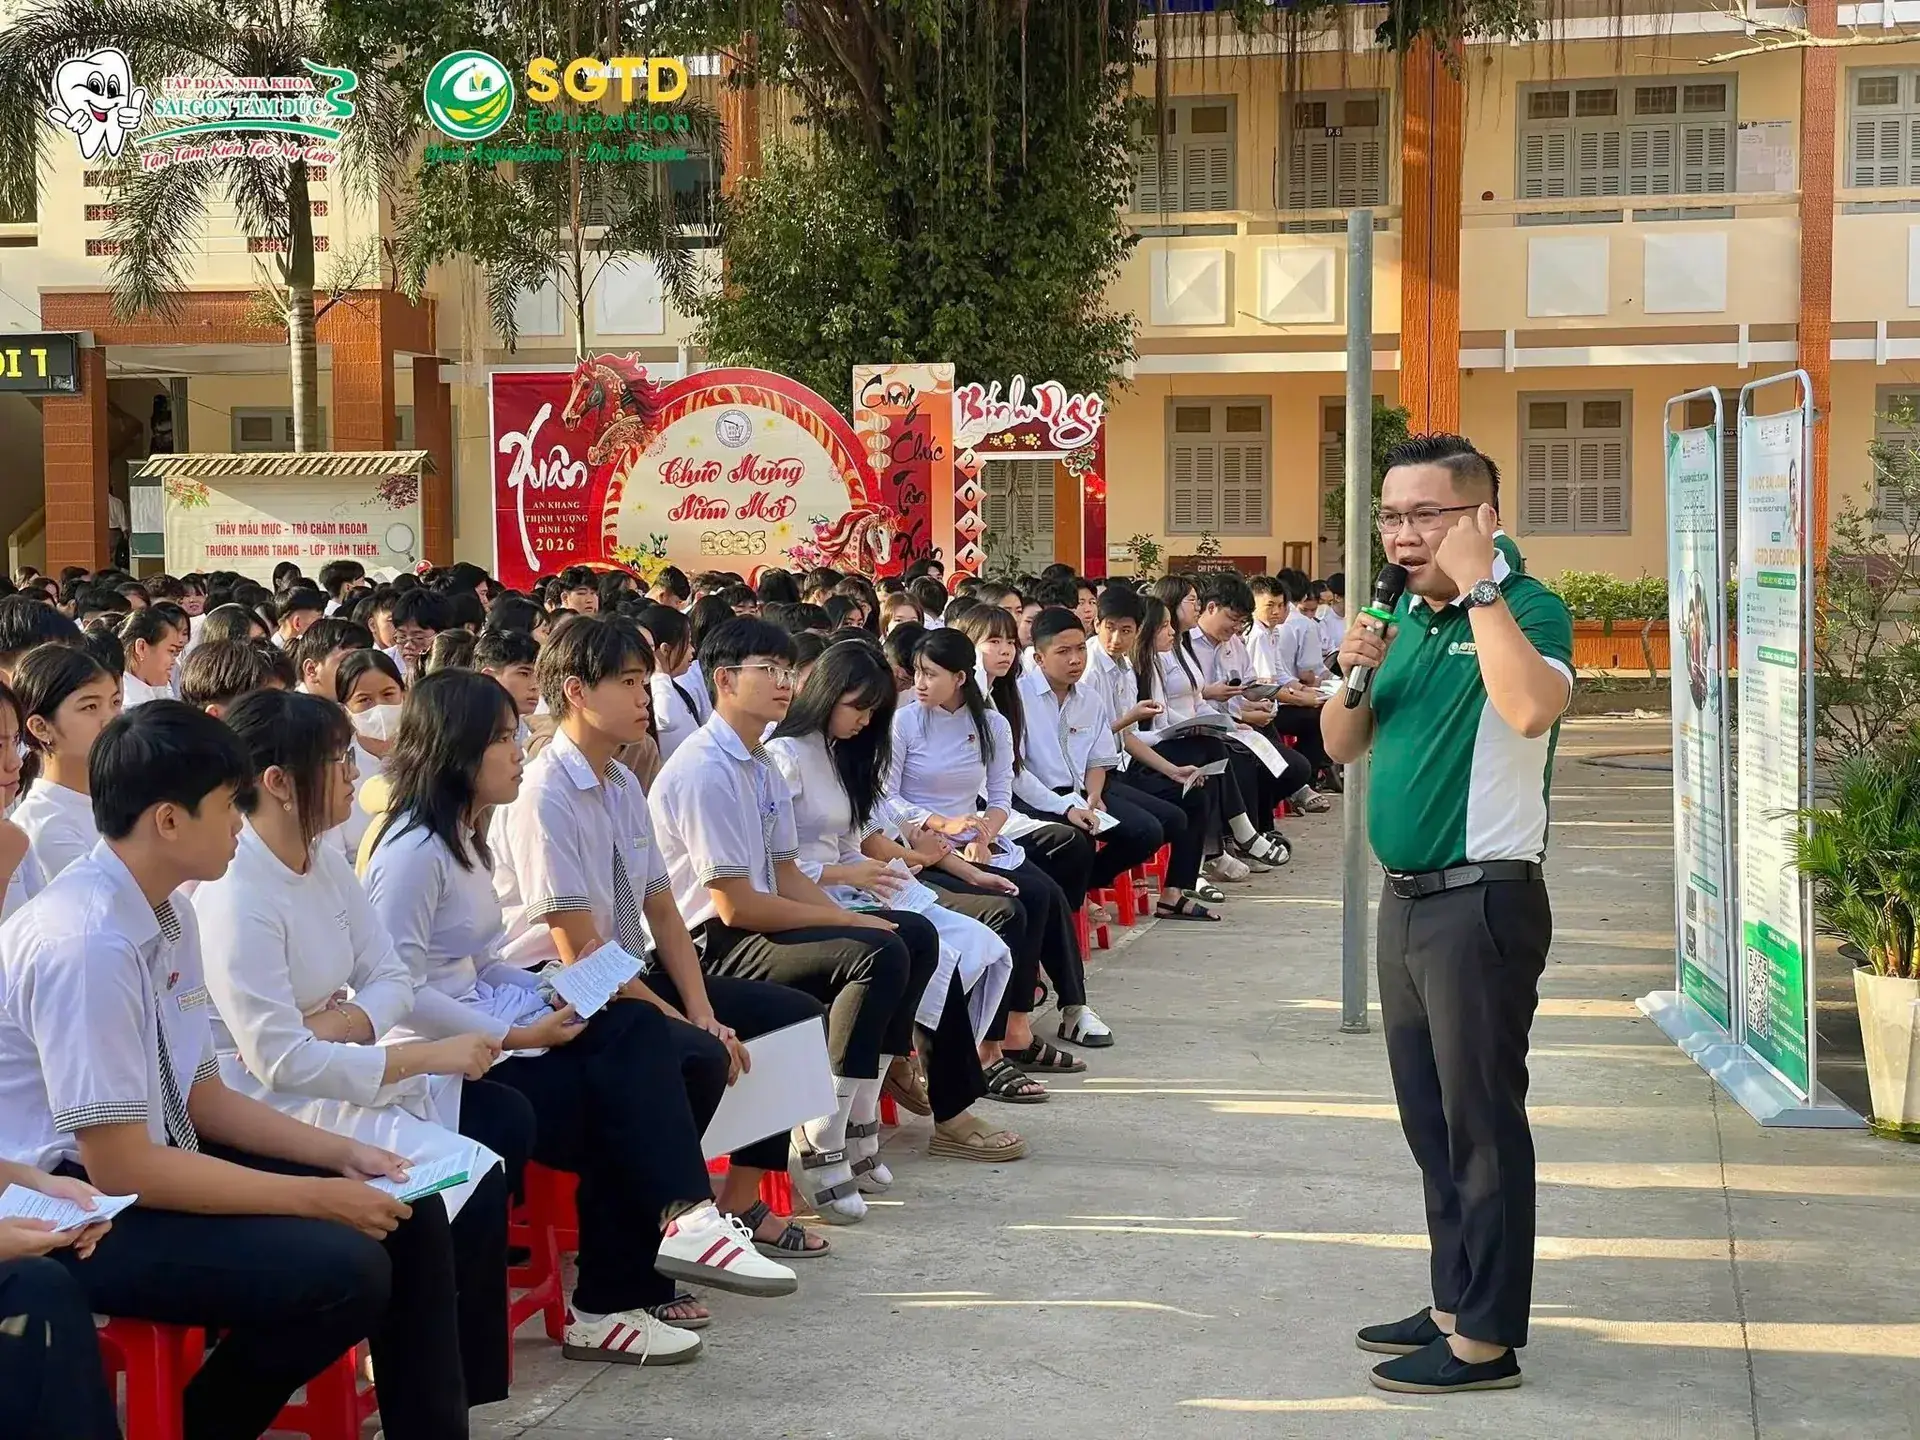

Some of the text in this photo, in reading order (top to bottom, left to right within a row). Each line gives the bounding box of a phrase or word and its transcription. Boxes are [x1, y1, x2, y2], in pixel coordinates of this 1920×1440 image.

[860, 373, 921, 426] Cung
[891, 430, 945, 464] Chúc
[658, 453, 805, 488] Chúc Mừng
[499, 402, 588, 572] Xuân
[892, 470, 927, 516] Tân
[548, 501, 580, 509] KHANG
[667, 491, 797, 522] Năm Mới
[339, 522, 368, 535] NGOAN
[525, 514, 588, 524] THỊNH VƯỢNG
[538, 524, 560, 533] BÌNH
[241, 545, 270, 557] KHANG
[272, 544, 299, 557] TRANG
[329, 541, 350, 556] THÂN
[535, 538, 575, 551] 2026
